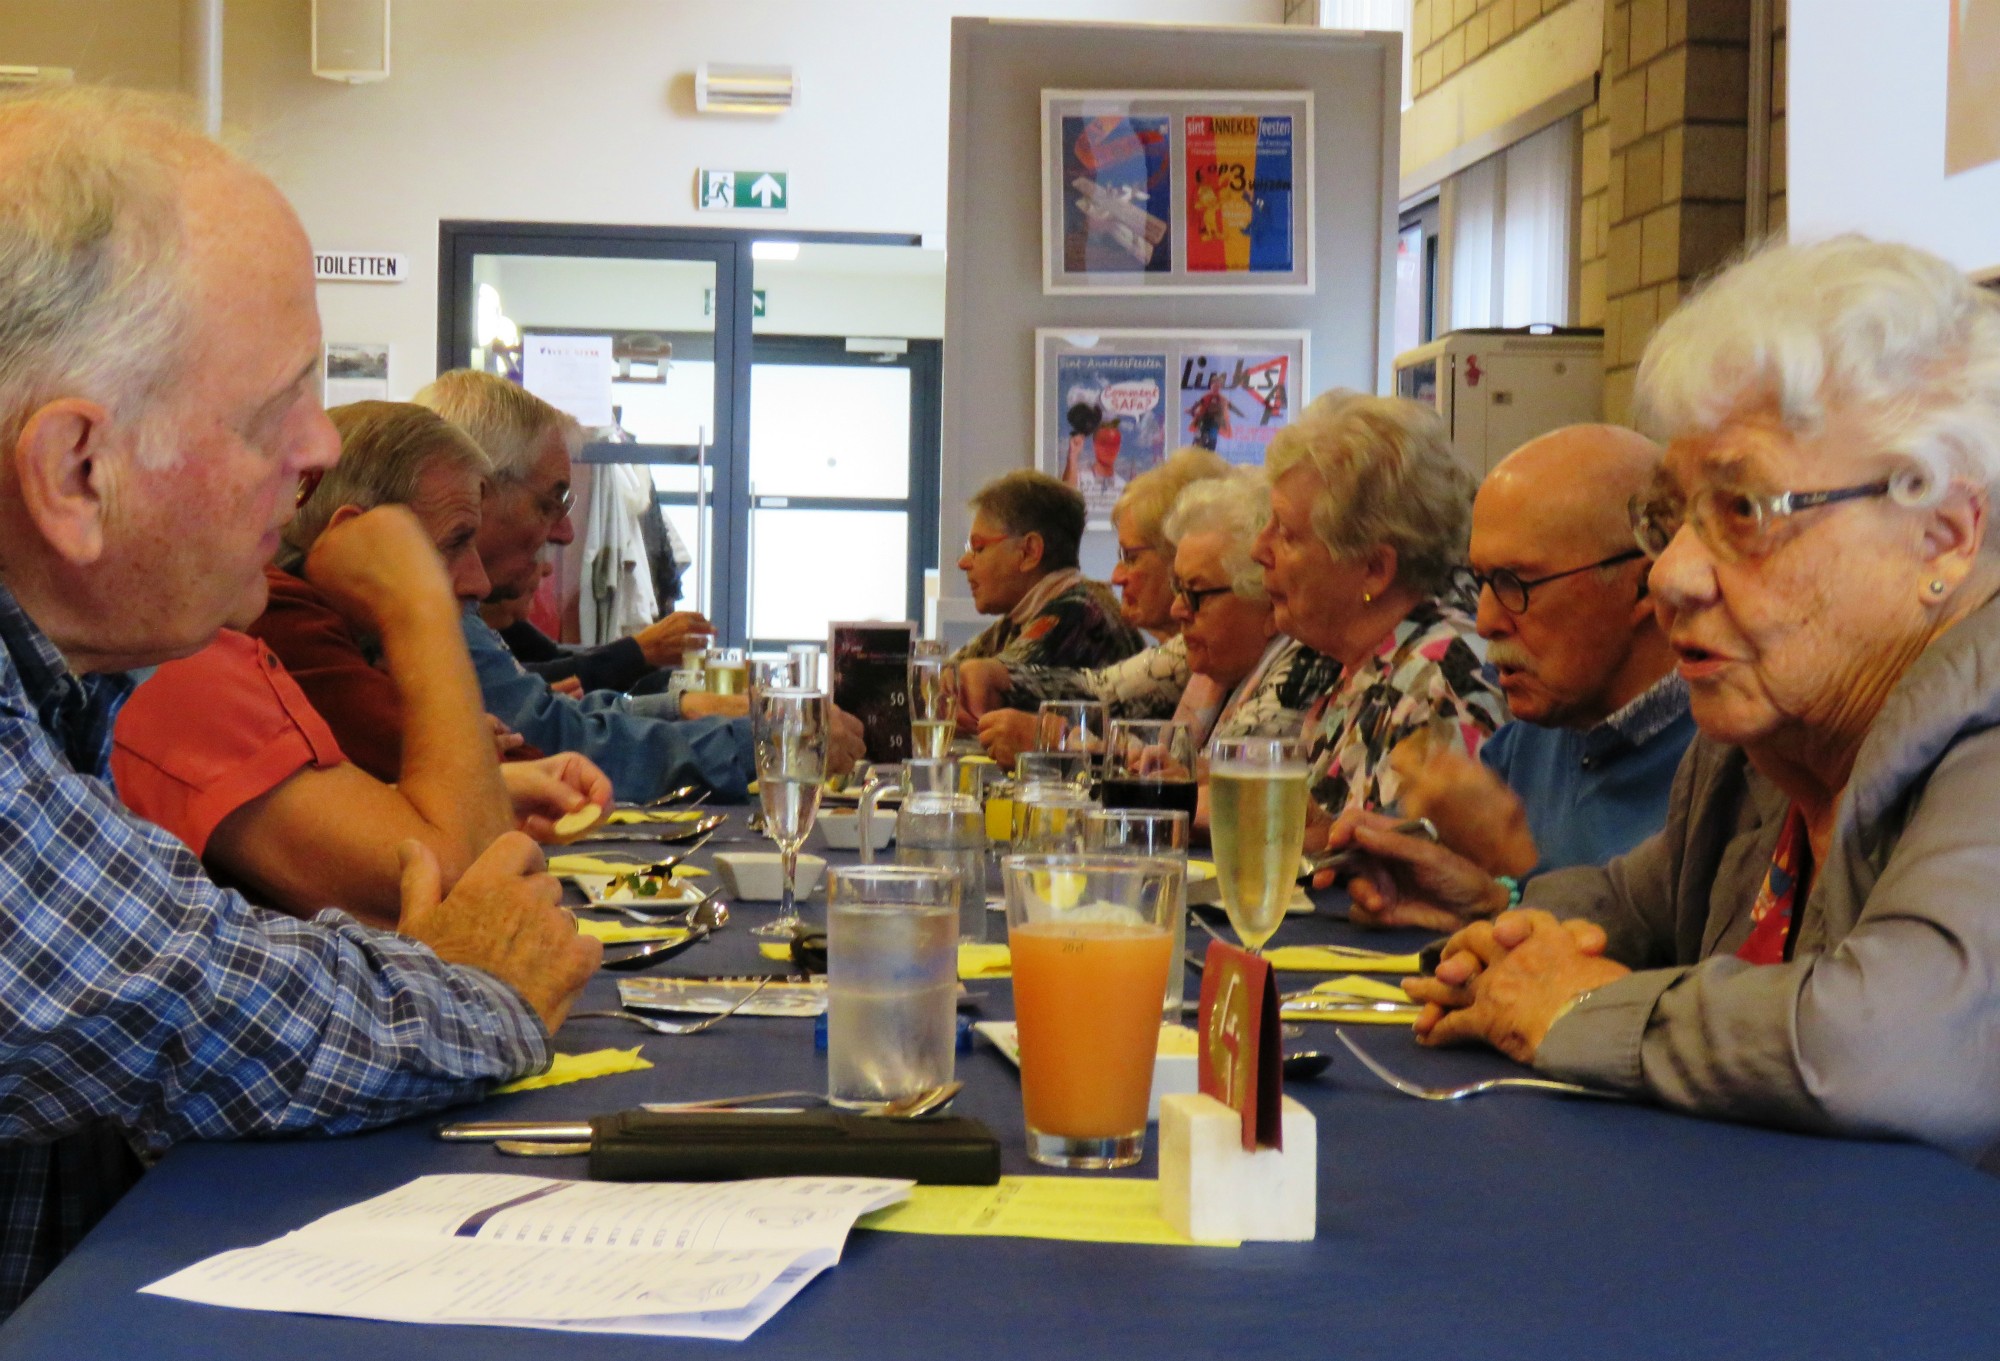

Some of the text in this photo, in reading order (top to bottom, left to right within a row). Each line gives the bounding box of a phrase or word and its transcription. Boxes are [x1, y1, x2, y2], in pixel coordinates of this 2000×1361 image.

[1208, 118, 1256, 135] ANNEKES
[1230, 163, 1246, 191] 3
[315, 255, 397, 276] TOILETTEN
[890, 692, 905, 706] 50
[889, 734, 903, 748] 50
